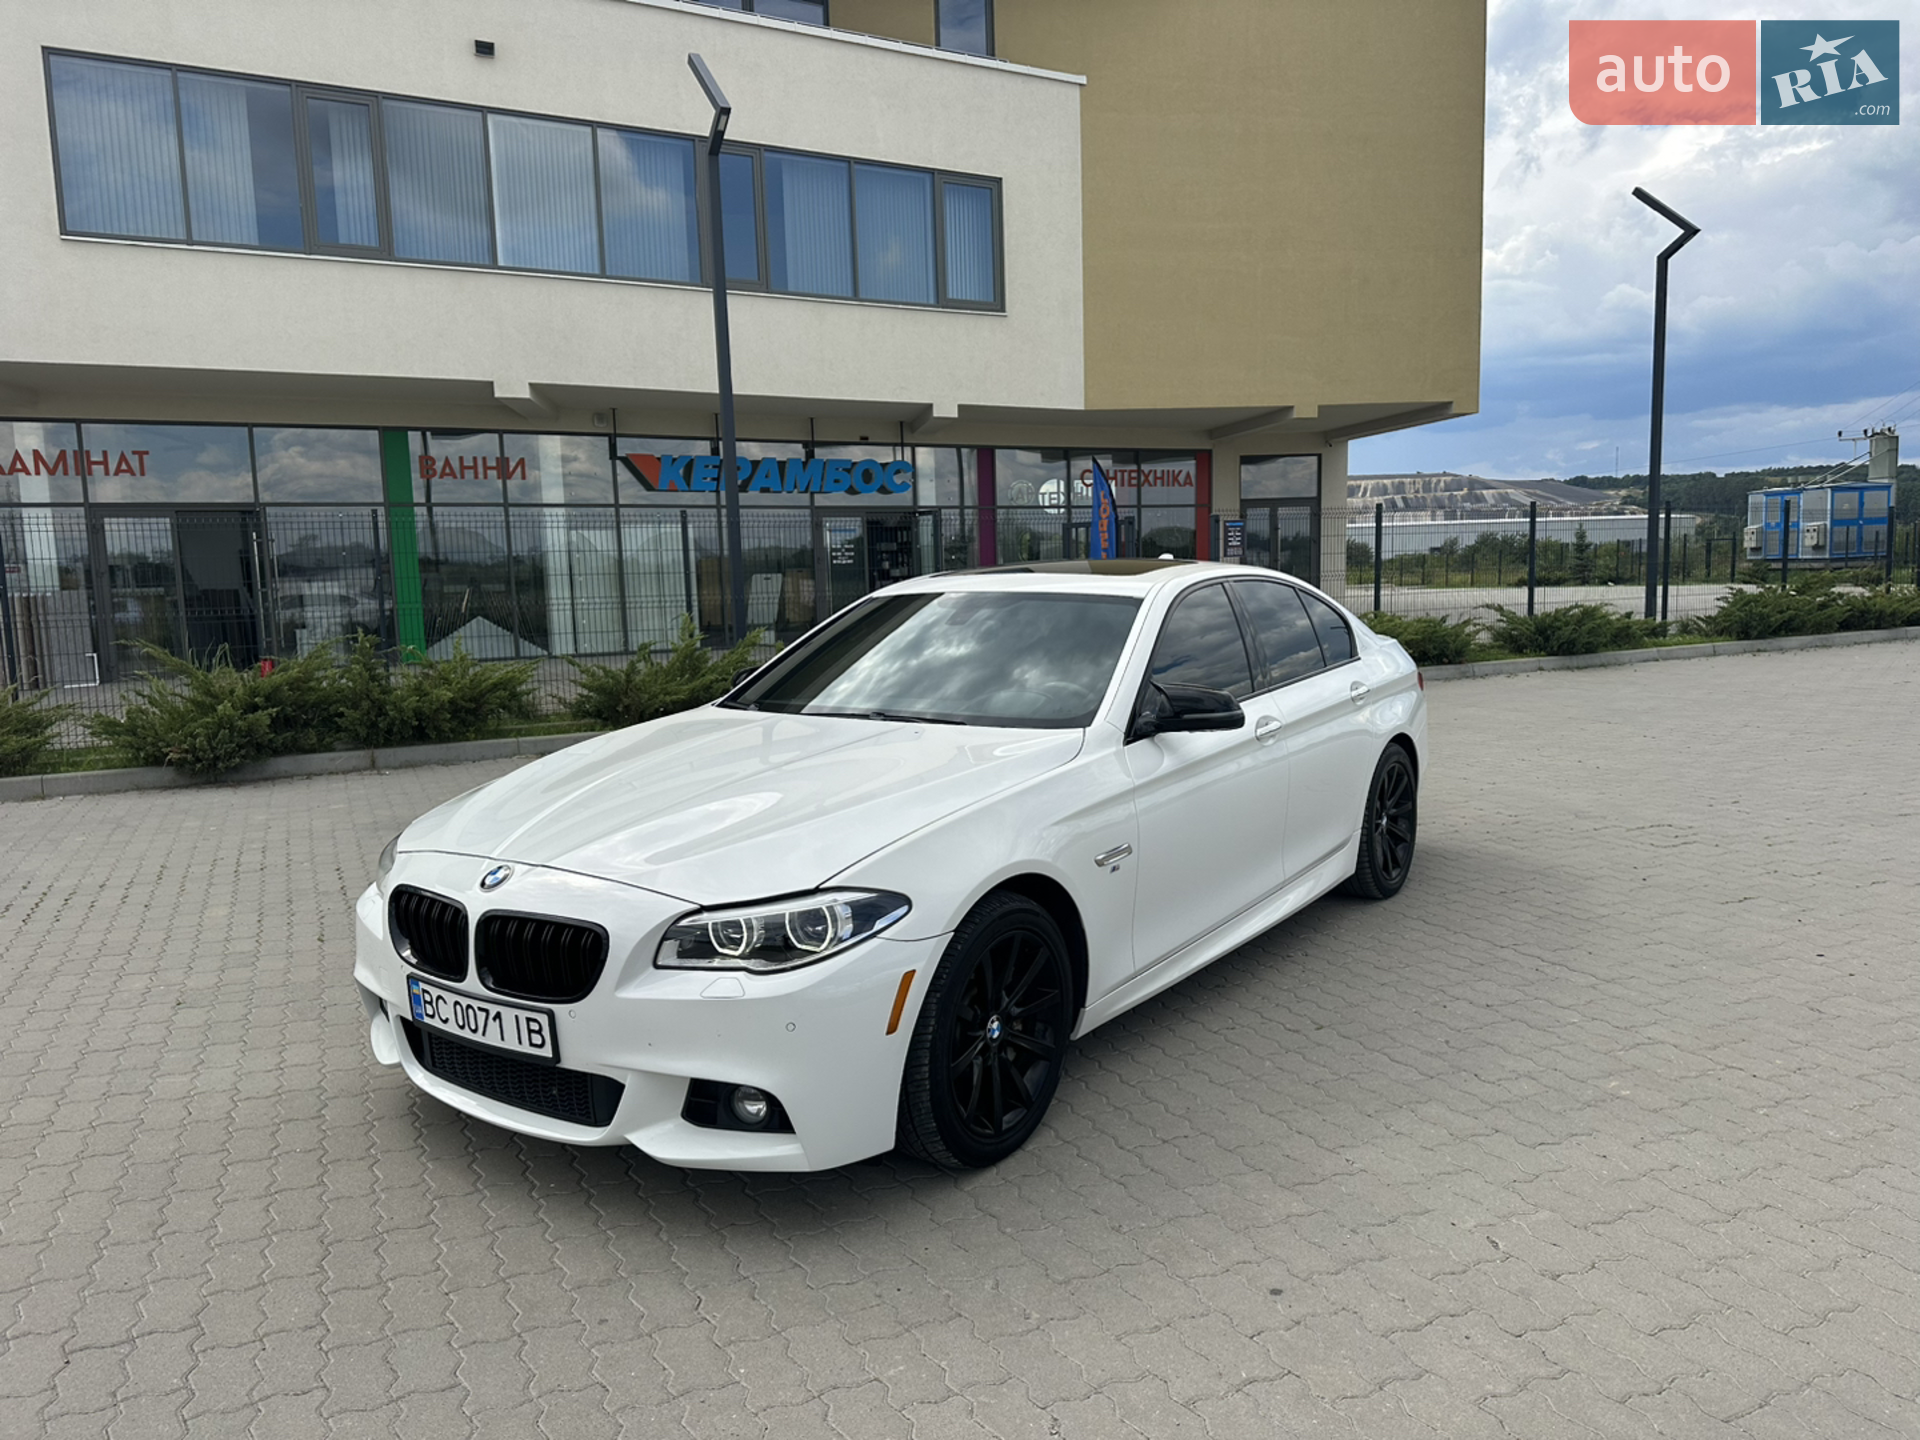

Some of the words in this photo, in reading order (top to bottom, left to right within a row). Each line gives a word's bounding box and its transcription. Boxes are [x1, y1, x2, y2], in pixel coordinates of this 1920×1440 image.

[418, 455, 527, 480] ВАННИ
[1080, 468, 1194, 488] СНТЕХНІКА
[421, 988, 450, 1025] BC
[453, 1000, 505, 1042] 0071
[514, 1014, 546, 1049] IB
